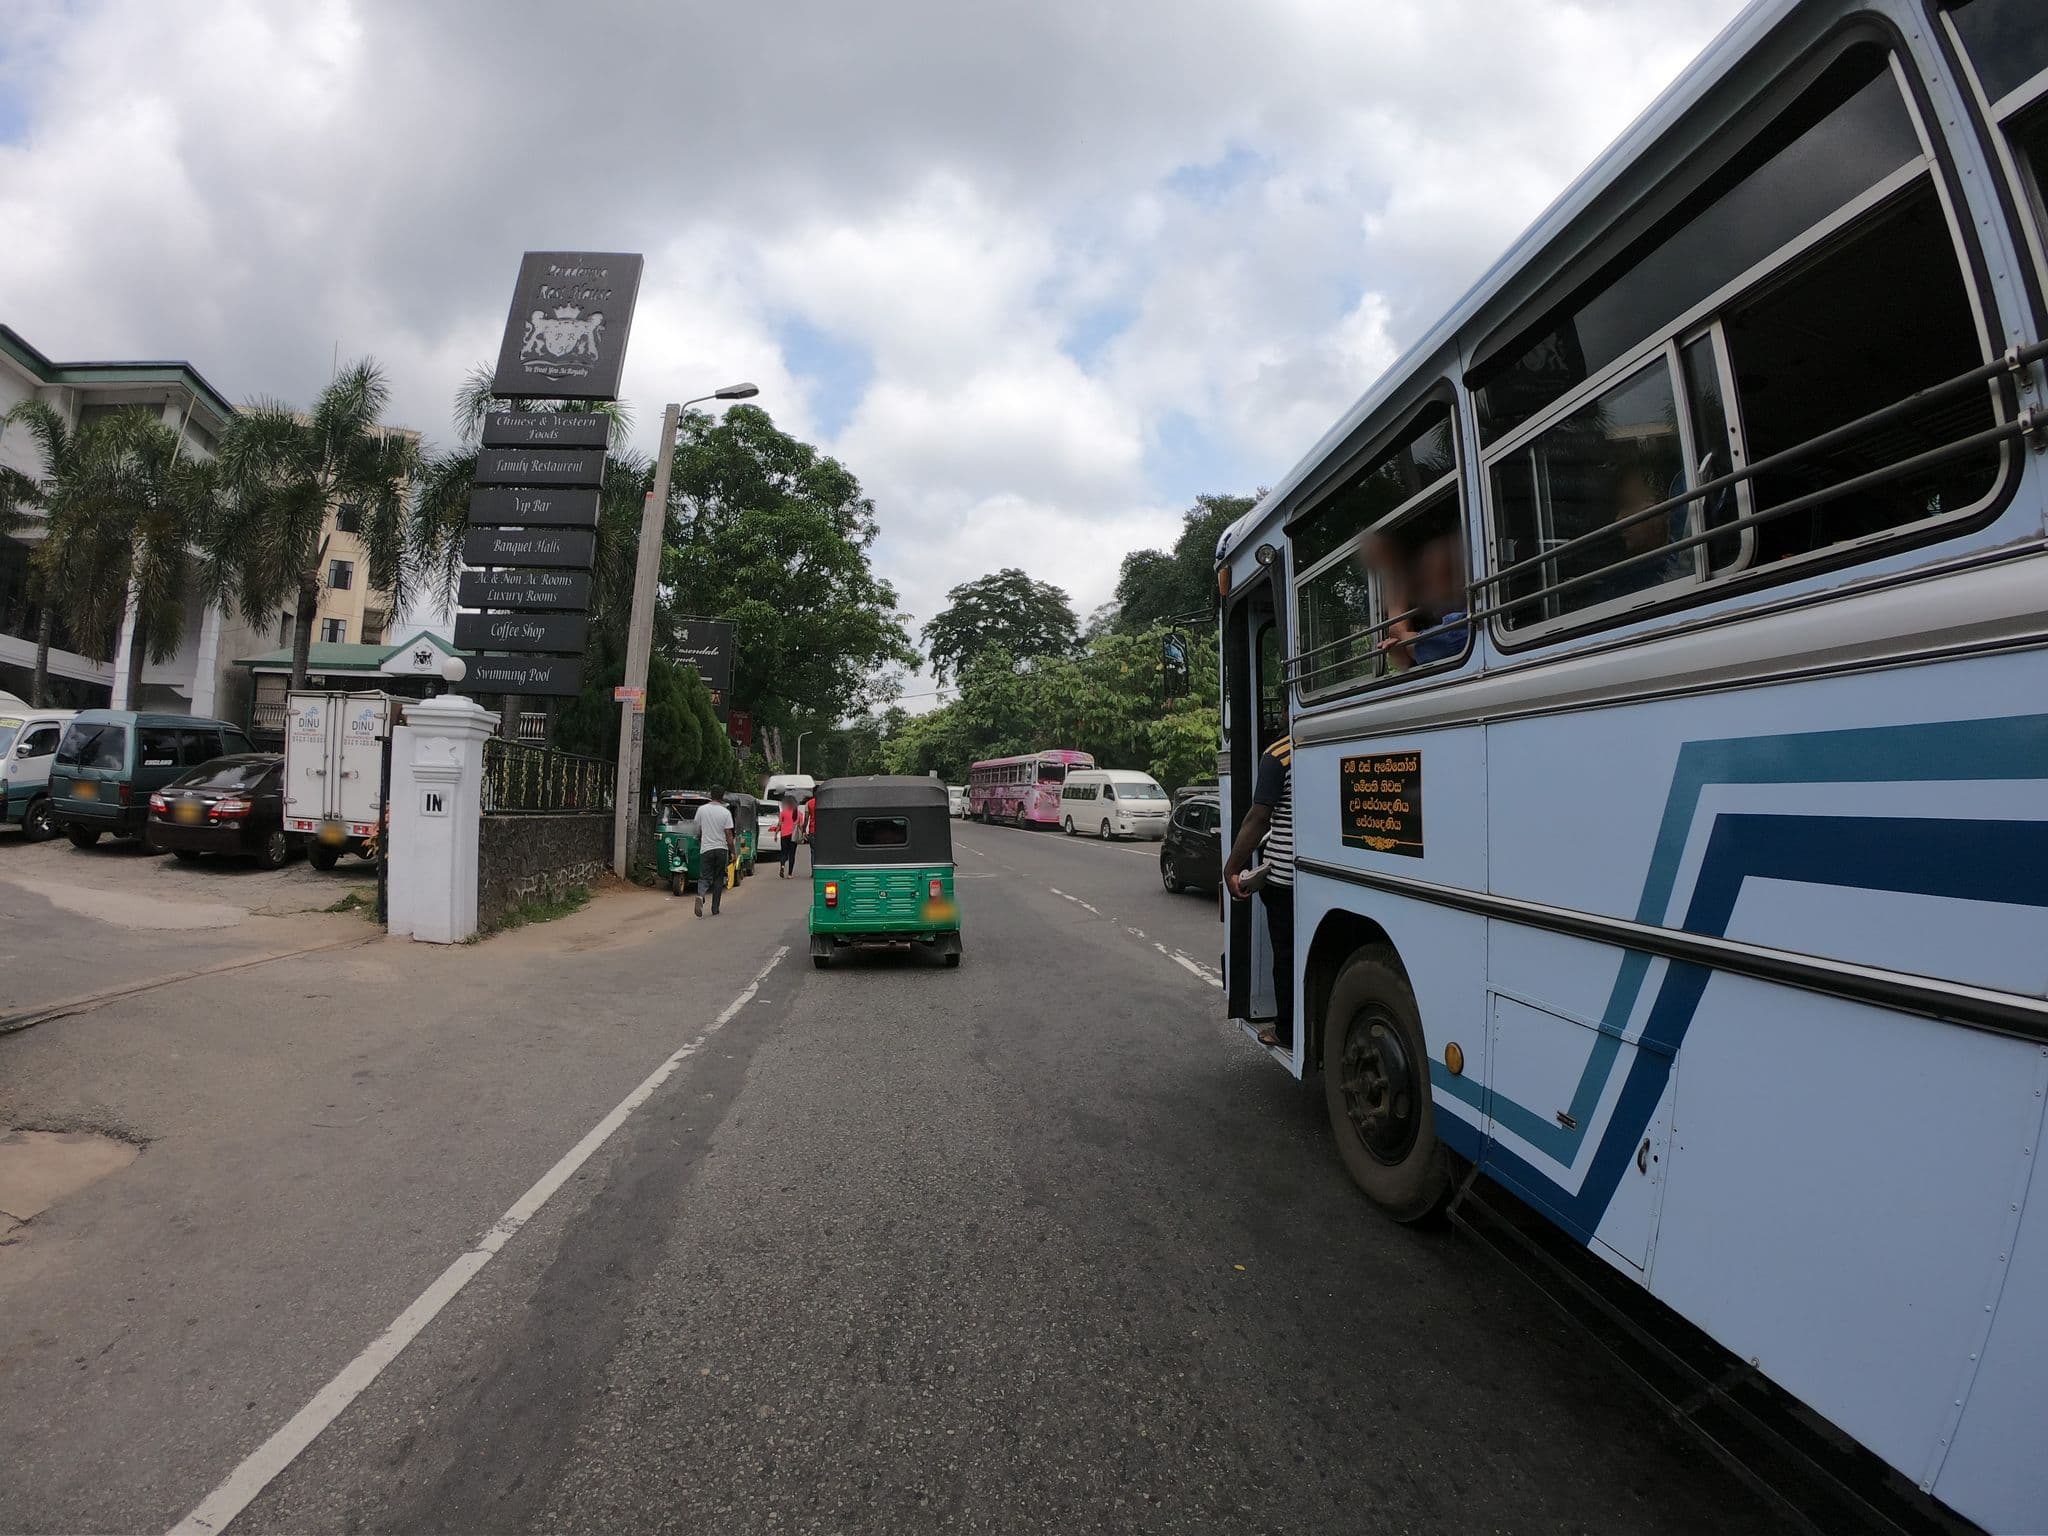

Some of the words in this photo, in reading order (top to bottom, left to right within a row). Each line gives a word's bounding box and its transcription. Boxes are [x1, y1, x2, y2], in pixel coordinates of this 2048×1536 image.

[496, 416, 537, 426] Chinese
[539, 416, 547, 426] &
[553, 415, 596, 427] Western
[526, 428, 559, 440] Foods
[494, 457, 529, 474] Family
[532, 499, 551, 512] Bar
[493, 539, 533, 556] Banquet
[534, 538, 560, 553] Halls
[490, 573, 499, 584] &
[500, 573, 522, 585] Non
[541, 573, 574, 586] Rooms
[487, 588, 524, 605] Luxury
[526, 589, 558, 602] Rooms
[491, 621, 519, 641] Coffee
[521, 622, 545, 643] Shop
[476, 665, 527, 686] Swimming
[529, 665, 553, 682] Pool
[426, 794, 442, 811] IN
